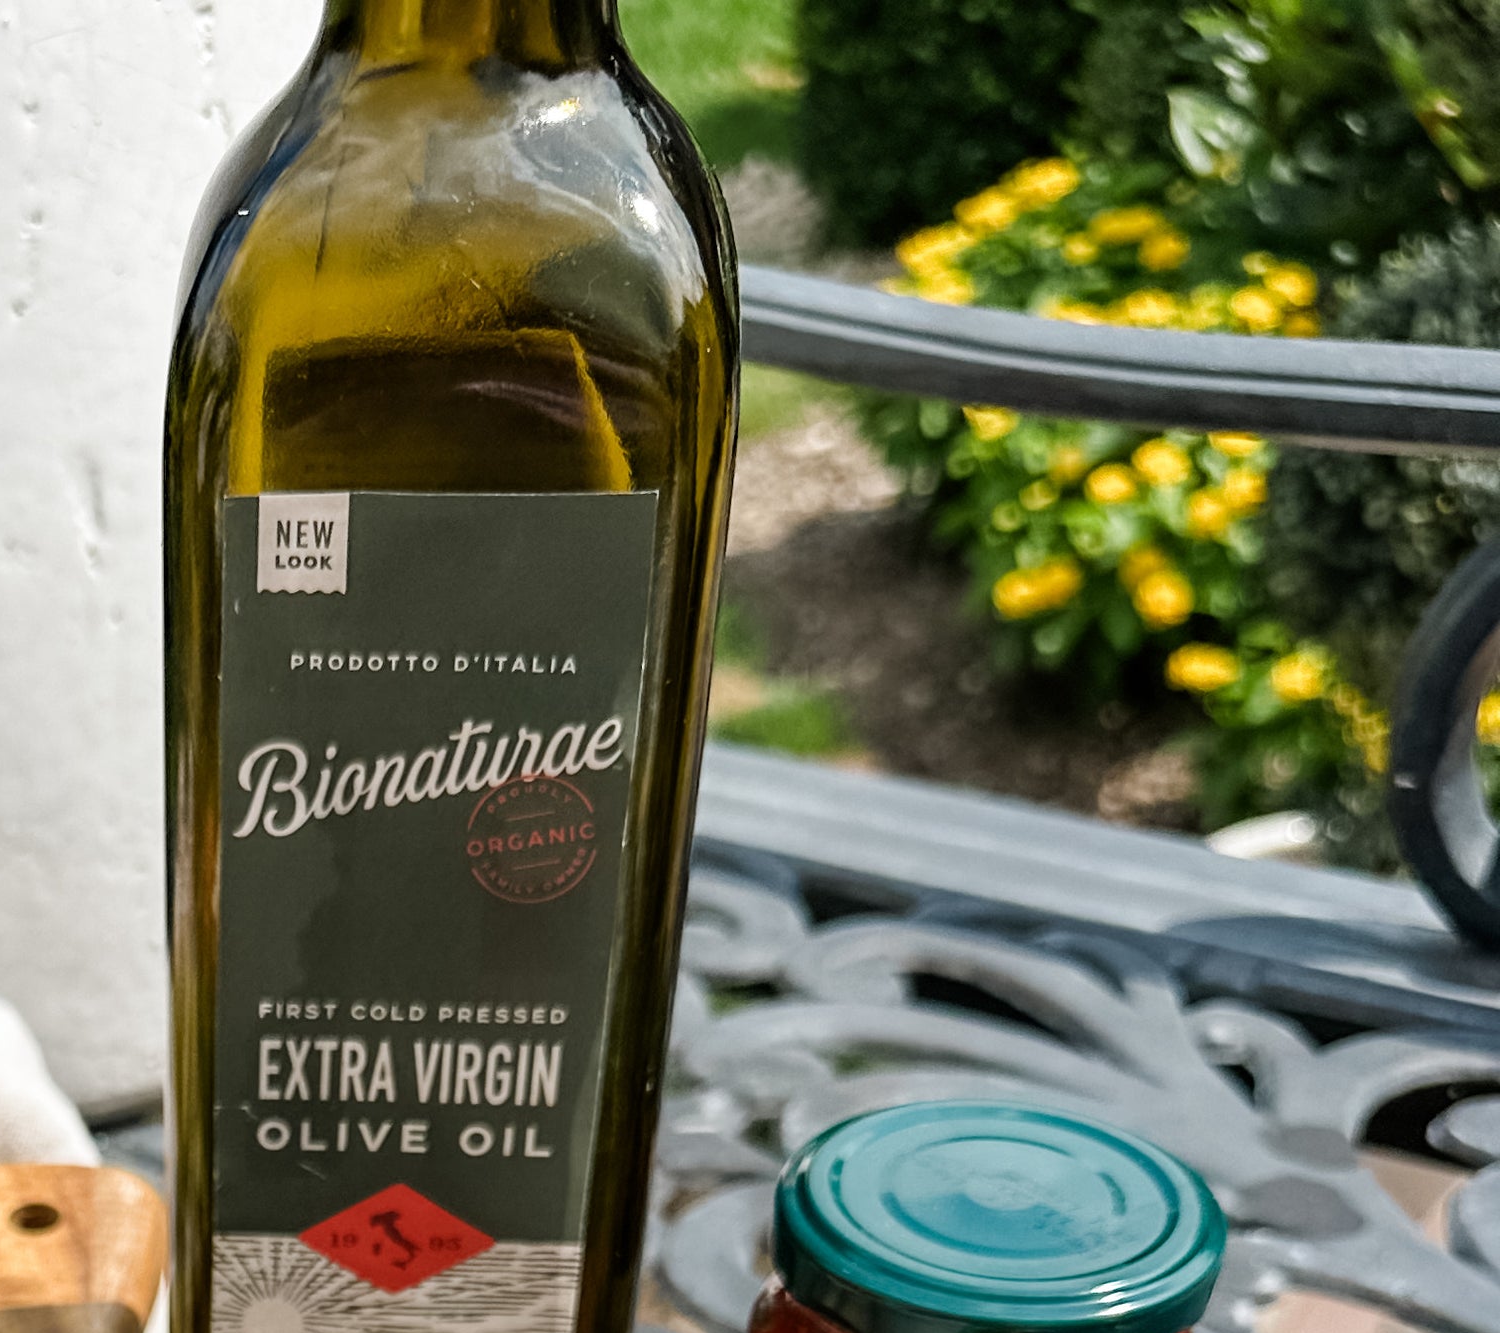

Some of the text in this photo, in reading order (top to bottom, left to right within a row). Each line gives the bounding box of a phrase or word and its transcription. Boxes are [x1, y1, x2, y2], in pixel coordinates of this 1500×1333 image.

[276, 520, 334, 549] NEW
[275, 554, 333, 570] LOOK
[290, 652, 577, 674] PRODOTTO D'ITALIA
[233, 715, 623, 838] Bionaturae
[467, 822, 596, 856] ORGANIC
[258, 1001, 568, 1025] FIRST COLD PRESSED
[257, 1038, 562, 1107] EXTRA VIRGIN
[256, 1119, 553, 1158] OLIVE OIL
